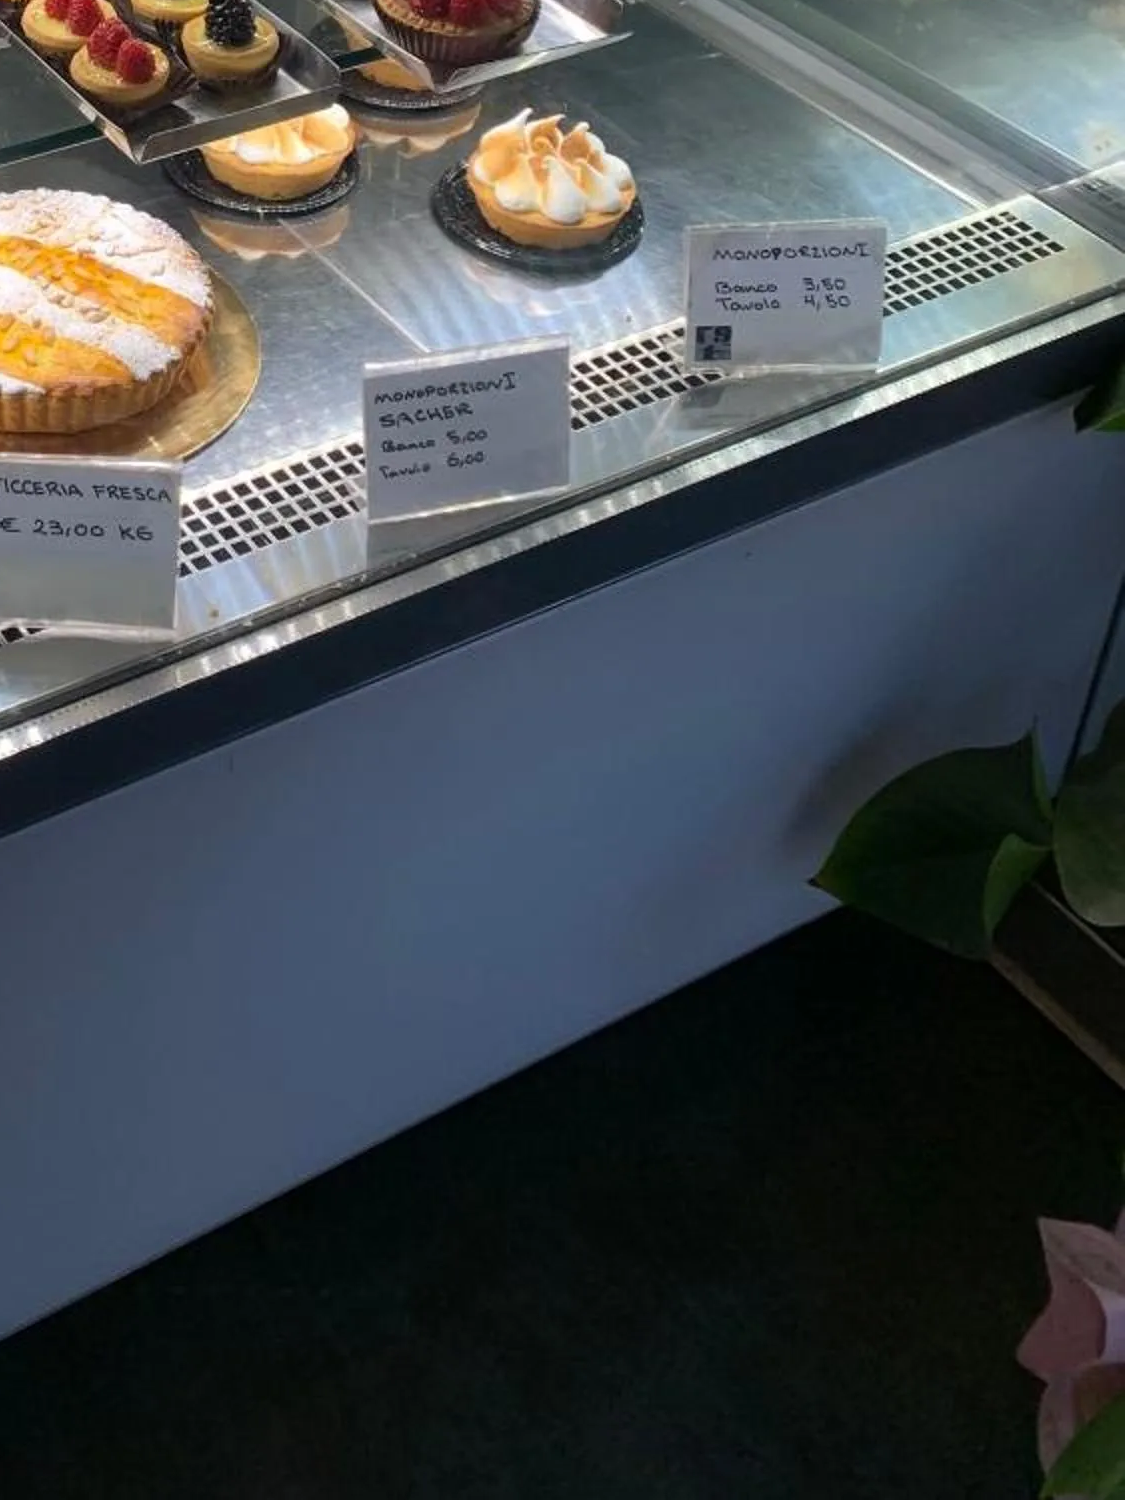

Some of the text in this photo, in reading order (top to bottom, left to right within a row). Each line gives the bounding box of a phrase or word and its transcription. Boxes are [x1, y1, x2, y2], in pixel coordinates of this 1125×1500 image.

[713, 242, 871, 261] MONOPORZIONI
[715, 281, 778, 294] Banco
[715, 295, 851, 312] Tavolo 4,50
[375, 371, 517, 404] MONOPORZIONI
[379, 402, 473, 428] SACHER
[92, 484, 173, 503] FRESCA
[33, 519, 106, 538] 23,00
